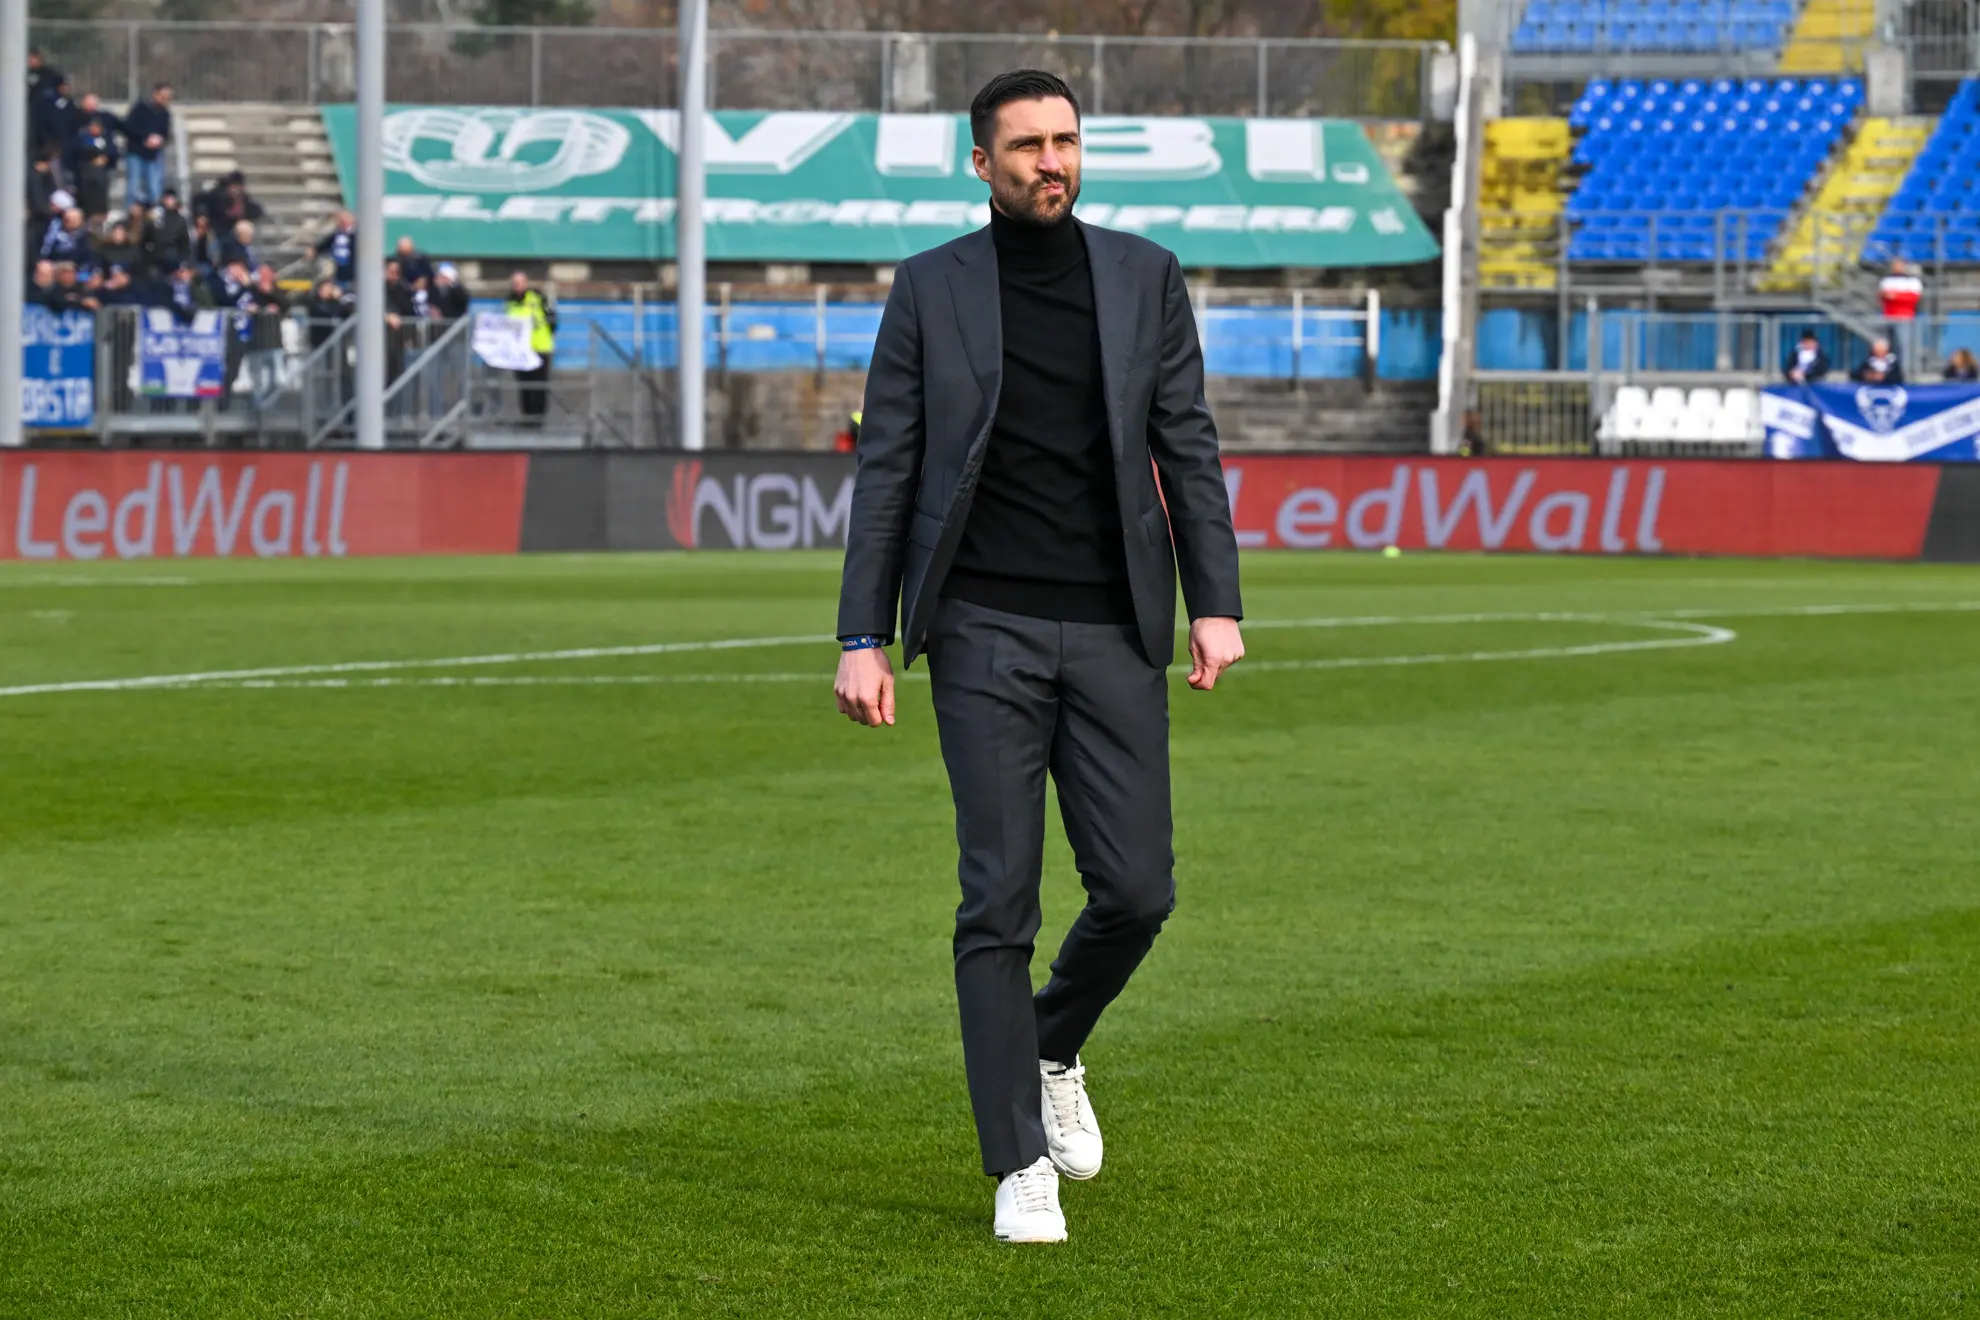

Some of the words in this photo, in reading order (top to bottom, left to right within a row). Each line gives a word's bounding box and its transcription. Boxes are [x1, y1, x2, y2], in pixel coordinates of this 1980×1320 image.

[16, 460, 350, 560] LedWall
[690, 466, 857, 549] NGM
[1223, 464, 1667, 553] LedWall
